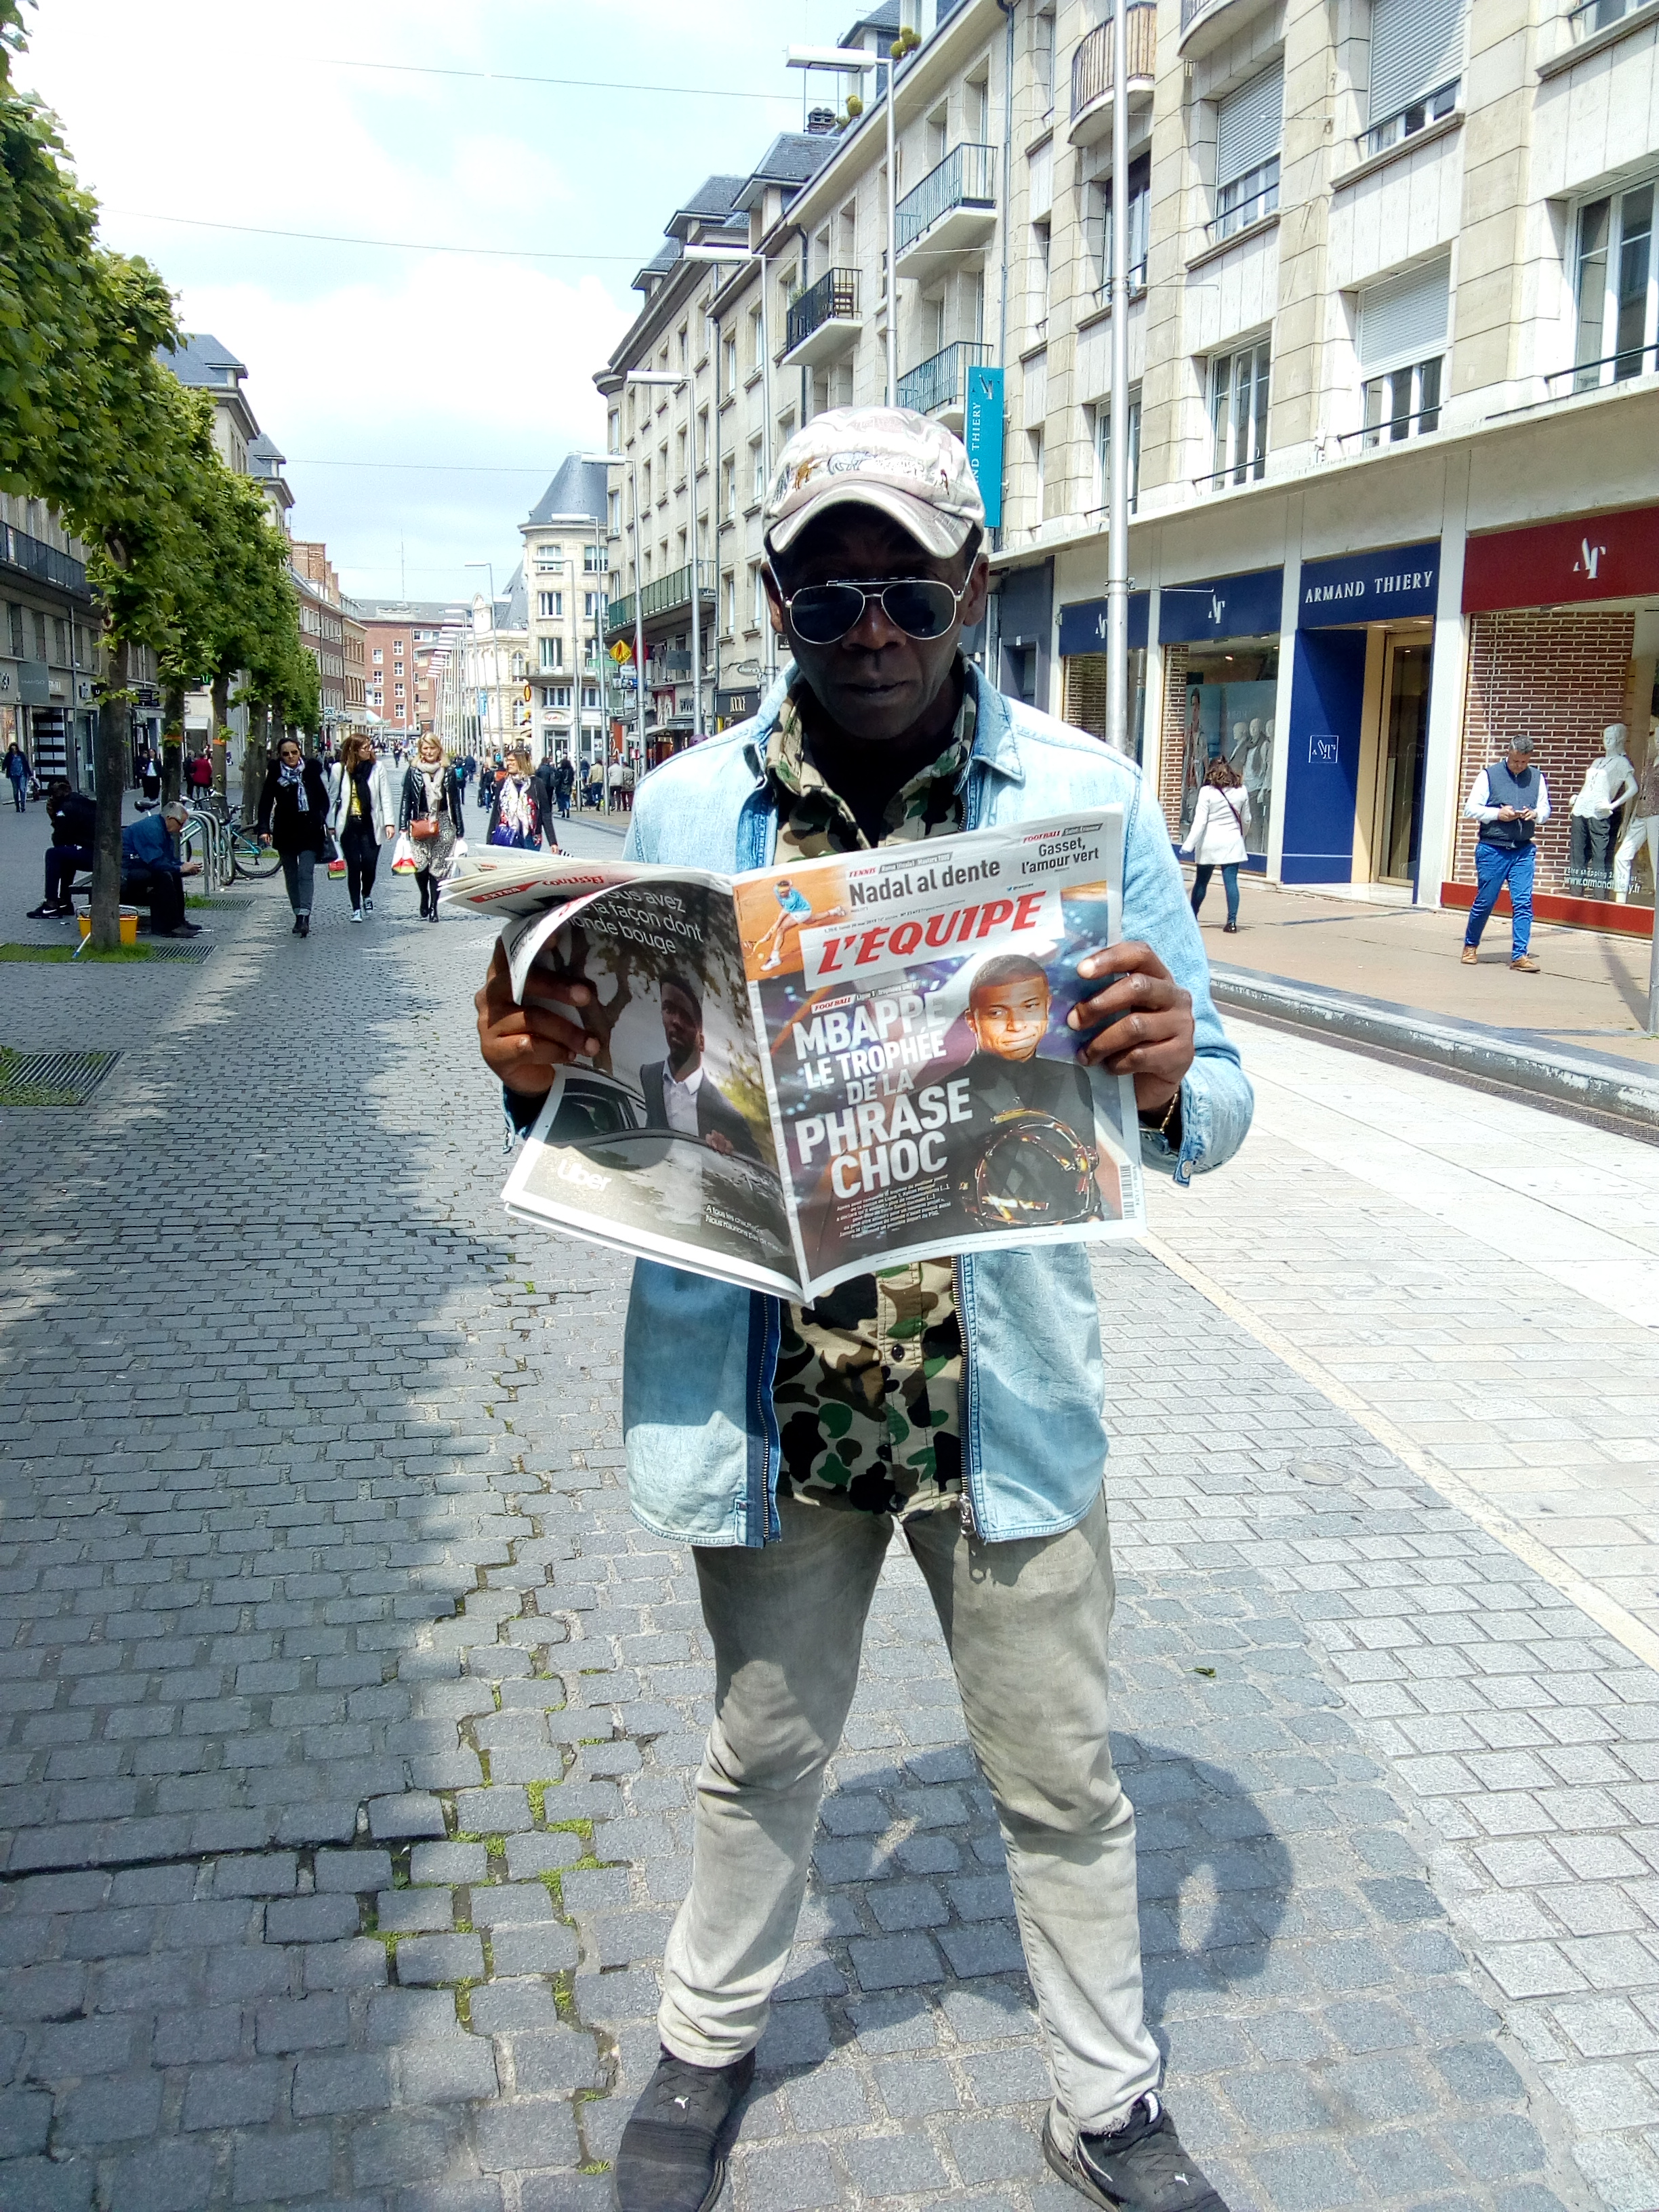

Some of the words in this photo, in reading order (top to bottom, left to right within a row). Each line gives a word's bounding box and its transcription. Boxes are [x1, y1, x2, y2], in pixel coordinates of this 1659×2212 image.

[971, 402, 982, 451] THIERY
[1305, 580, 1366, 604] ARMAND
[1374, 570, 1434, 594] THIERY
[1021, 855, 1071, 874] l'amour
[1073, 847, 1099, 863] vert
[1039, 836, 1086, 857] Gasset,
[849, 867, 877, 878] TENNIS
[849, 873, 914, 907] Nadal
[917, 868, 938, 893] al
[942, 859, 1001, 888] dente
[591, 902, 611, 916] la
[608, 900, 661, 928] façon
[663, 913, 704, 943] dont
[643, 892, 687, 914] avez
[617, 920, 677, 956] bouge
[791, 979, 946, 1061] MBAPPÉ
[815, 997, 851, 1011] FOOTBALL
[803, 1057, 835, 1090] LE
[835, 1025, 947, 1081] TROPHÉE
[846, 1076, 878, 1106] DE
[882, 1068, 915, 1097] LA
[795, 1077, 973, 1165] PHRASE
[557, 1158, 613, 1191] Uber
[831, 1130, 948, 1200] CHOC
